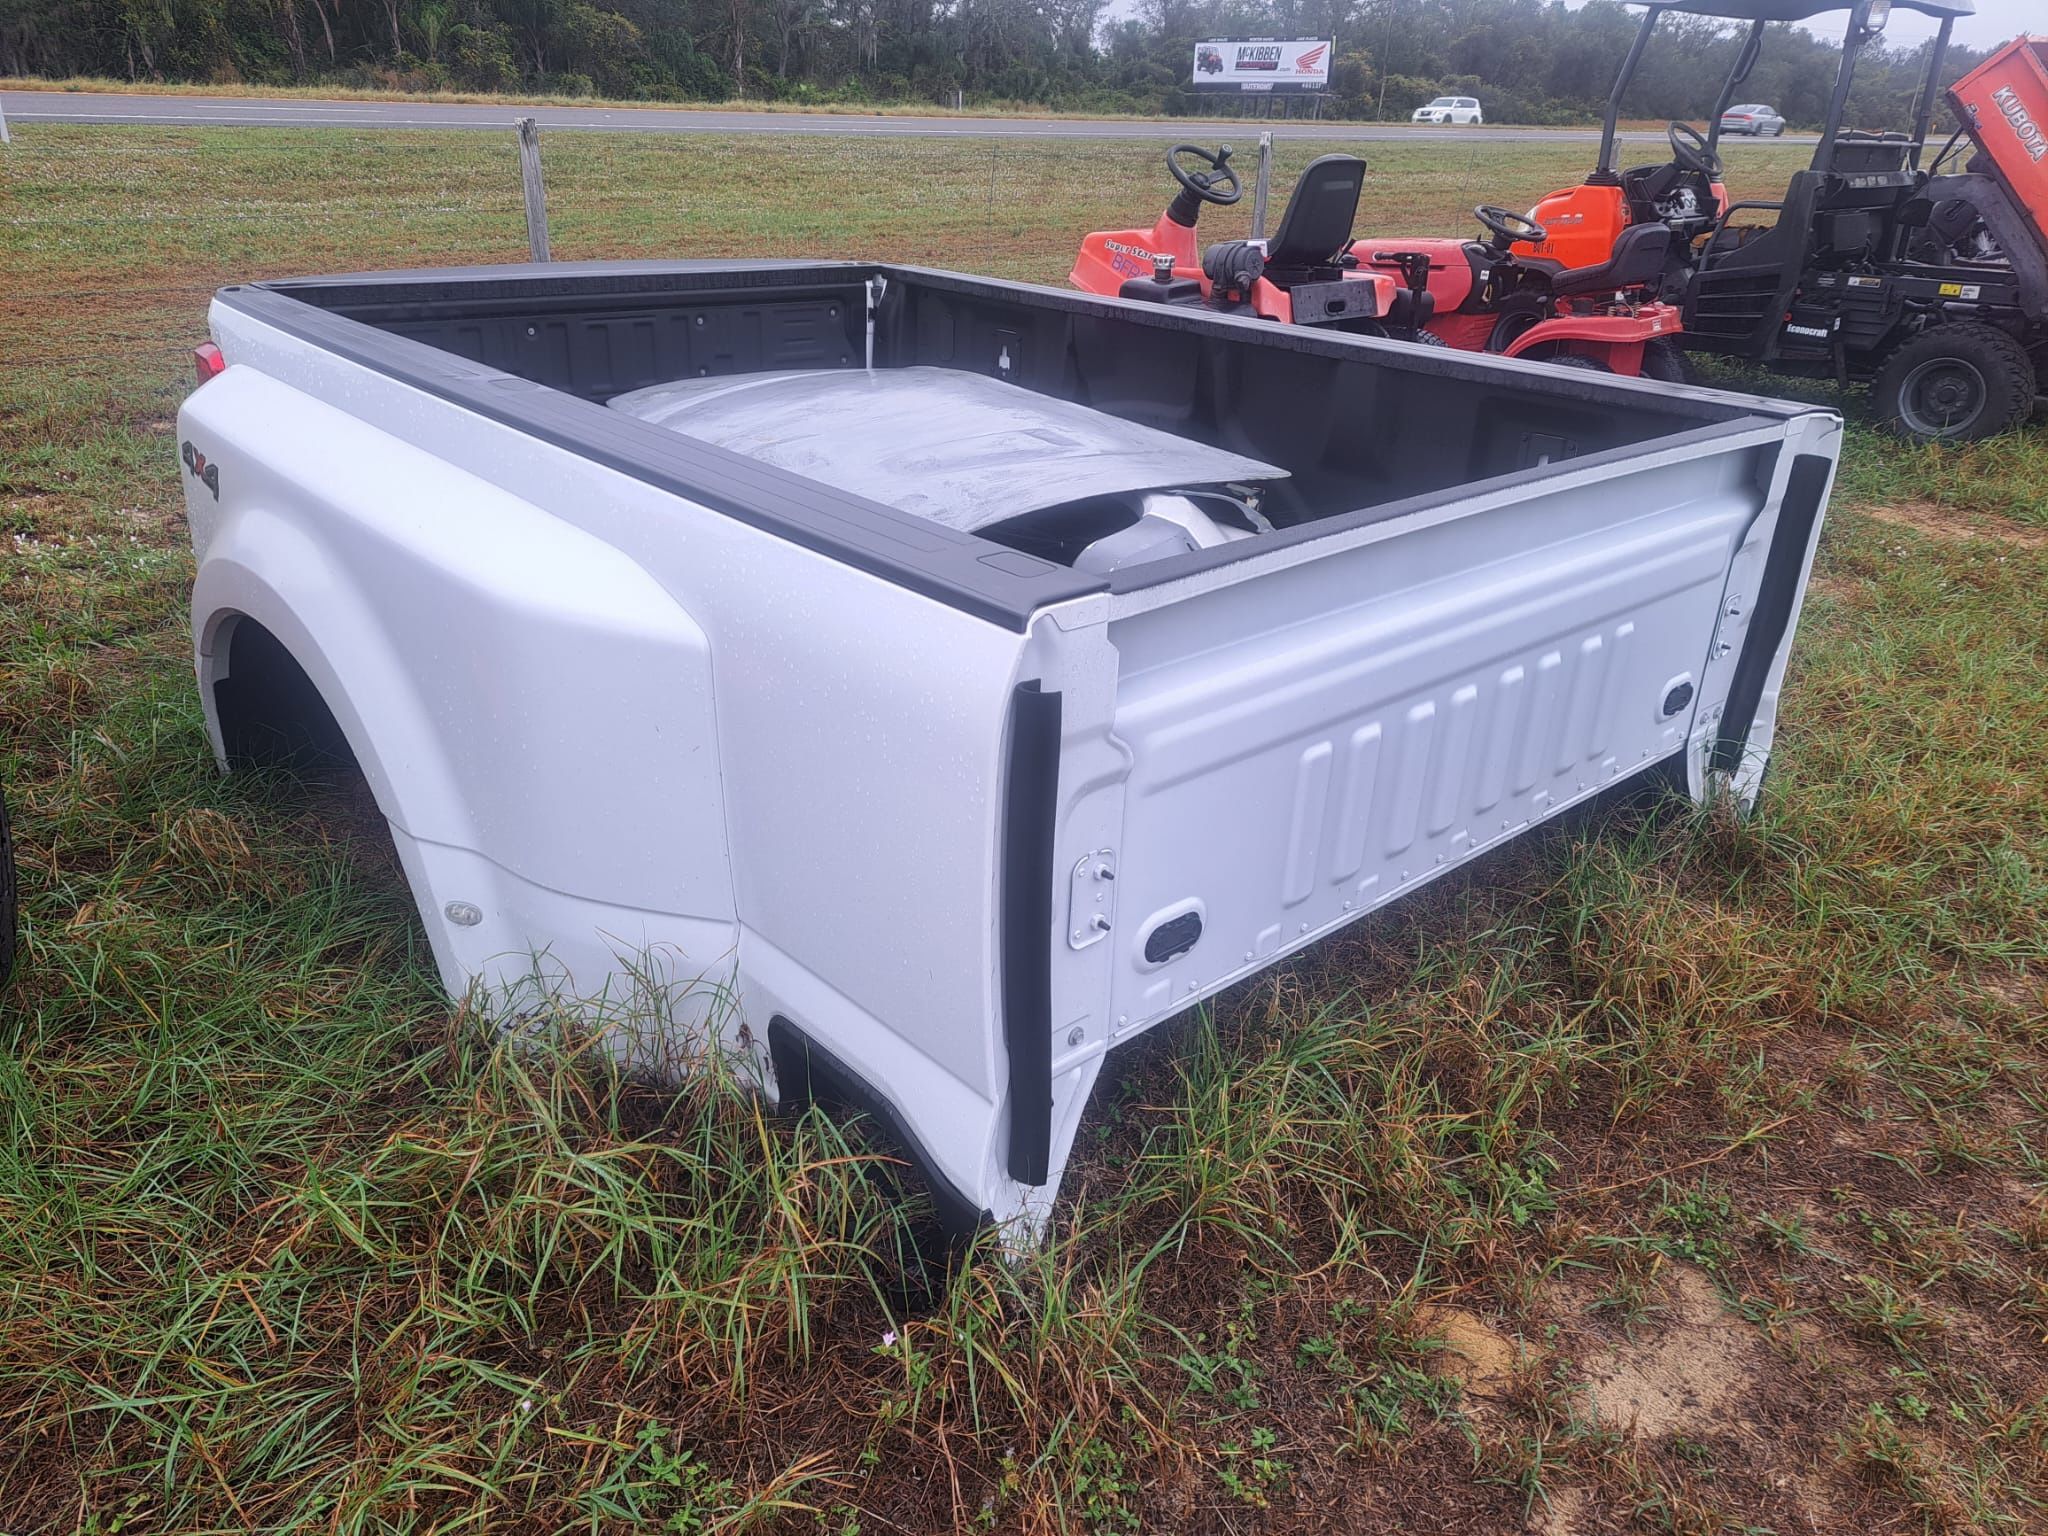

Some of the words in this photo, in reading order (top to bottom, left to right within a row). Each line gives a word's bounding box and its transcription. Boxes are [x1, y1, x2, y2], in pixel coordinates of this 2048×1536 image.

[1991, 84, 2048, 163] KUBOTA
[1105, 239, 1129, 254] Super
[1132, 247, 1154, 260] Star
[1787, 323, 1828, 338] Econocraft
